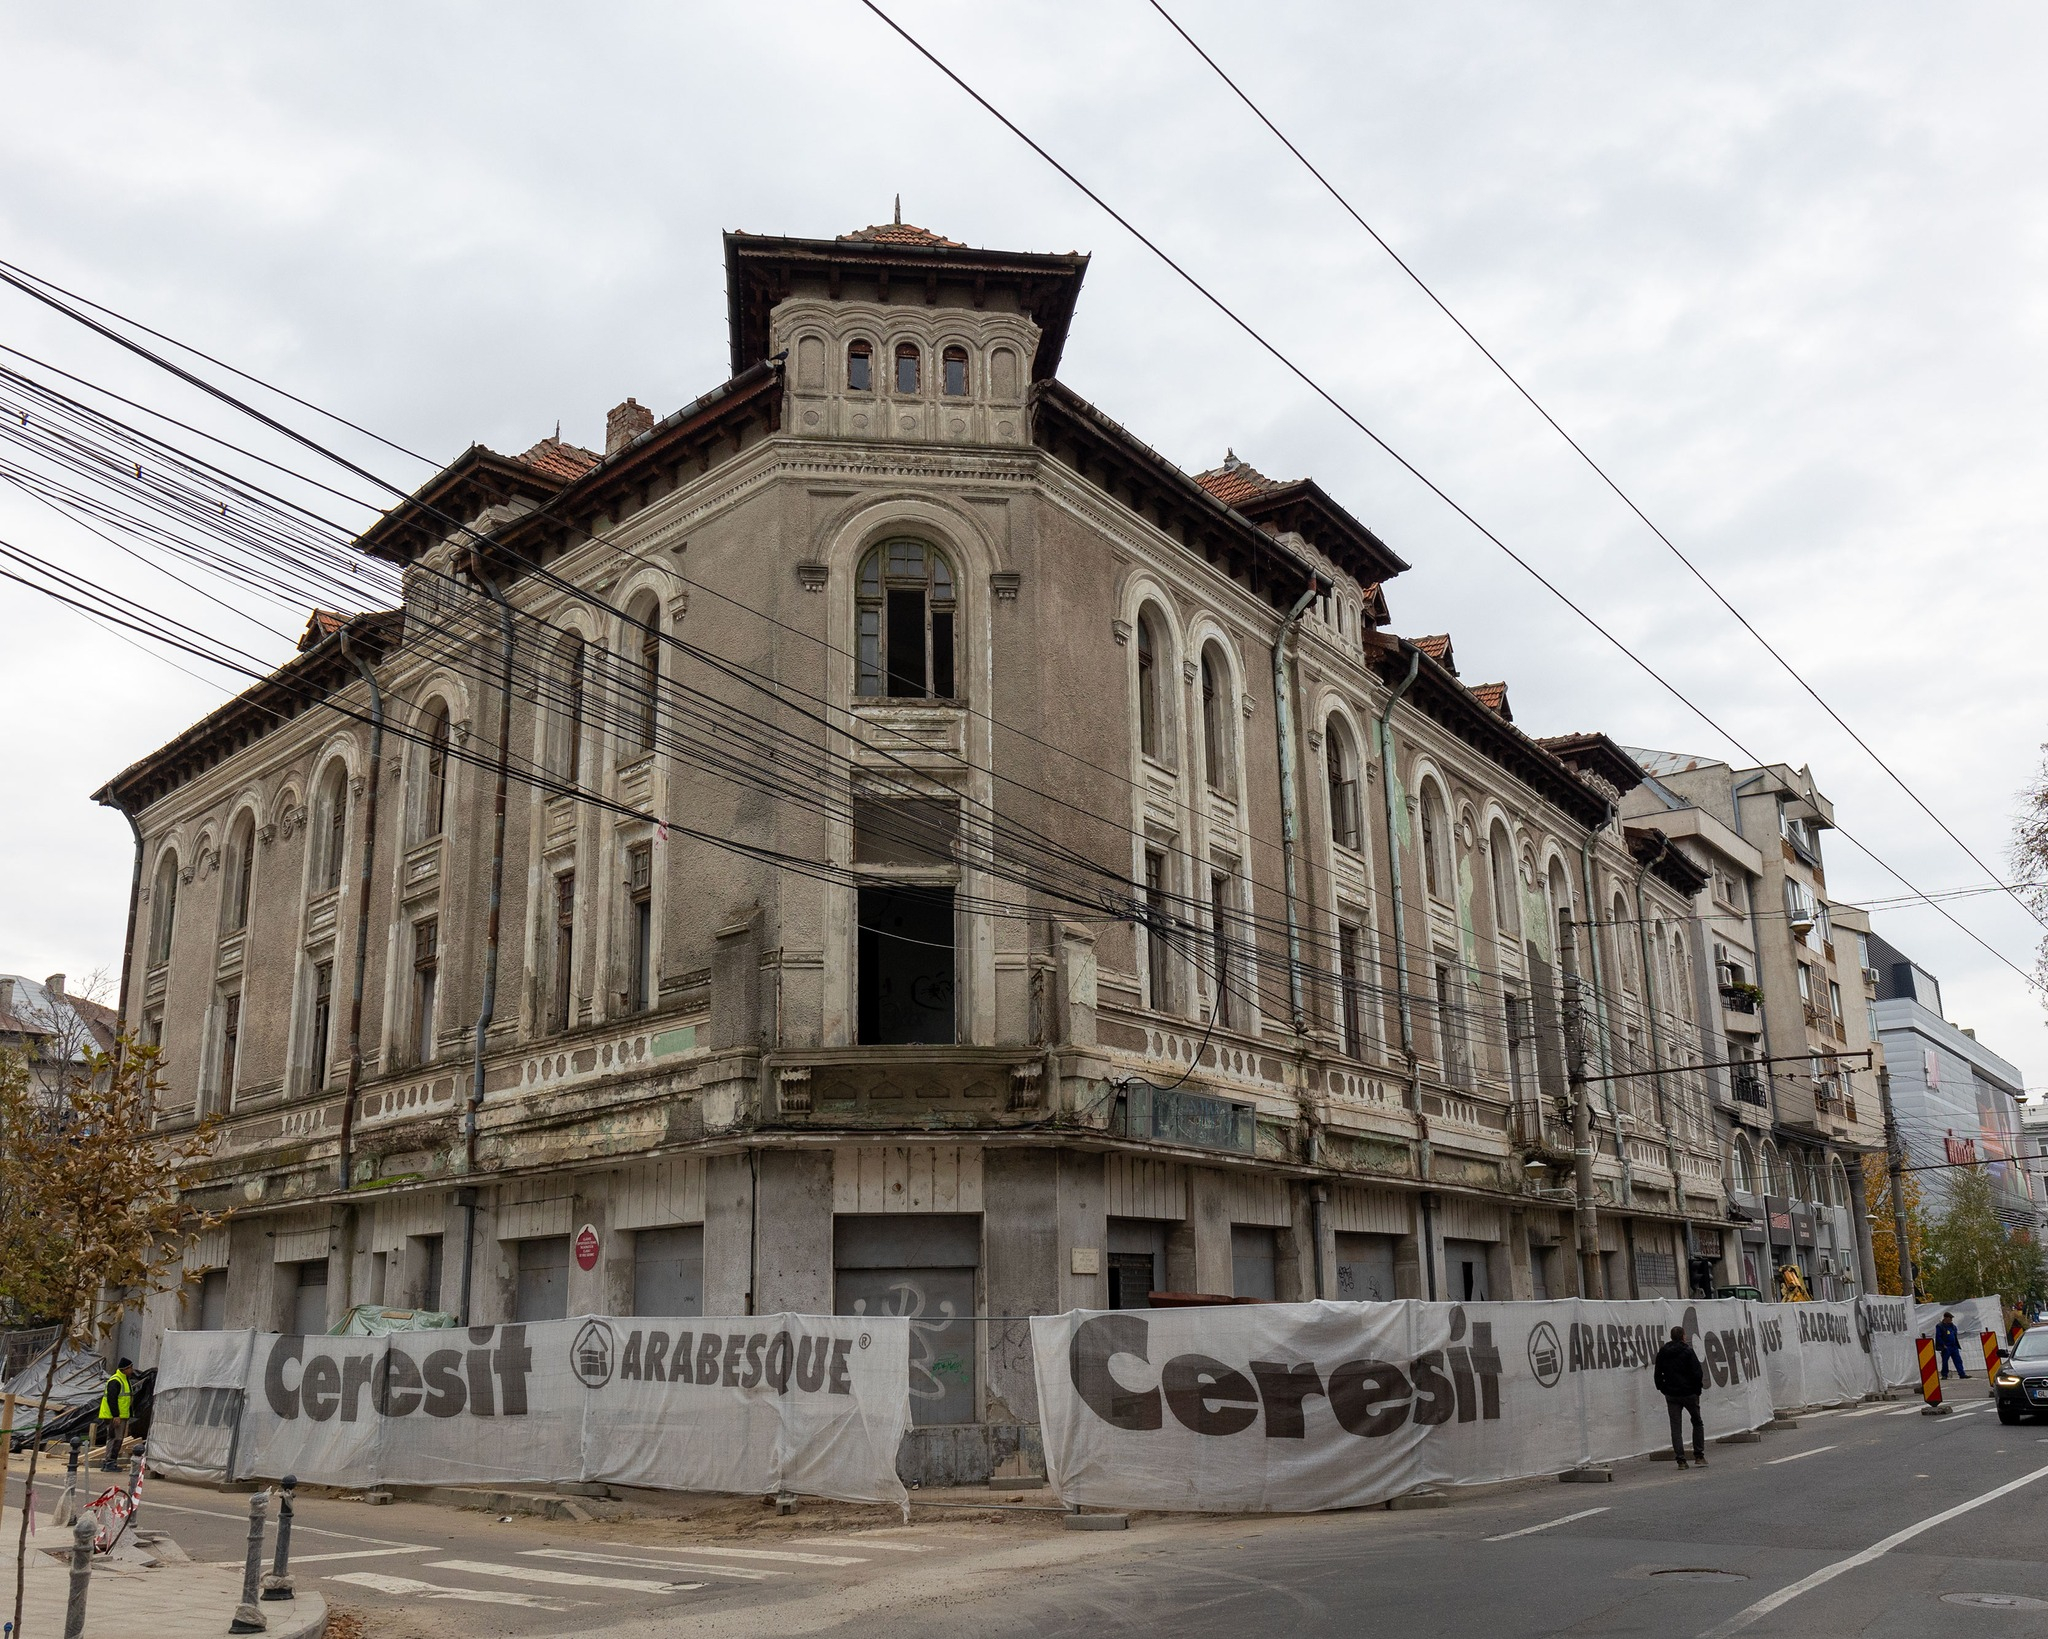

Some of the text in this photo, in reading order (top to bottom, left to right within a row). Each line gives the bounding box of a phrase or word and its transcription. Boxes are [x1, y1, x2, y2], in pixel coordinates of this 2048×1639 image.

[264, 1325, 532, 1422] Ceresit
[620, 1330, 853, 1396] ARABESQUE
[1069, 1305, 1503, 1439] Ceresit
